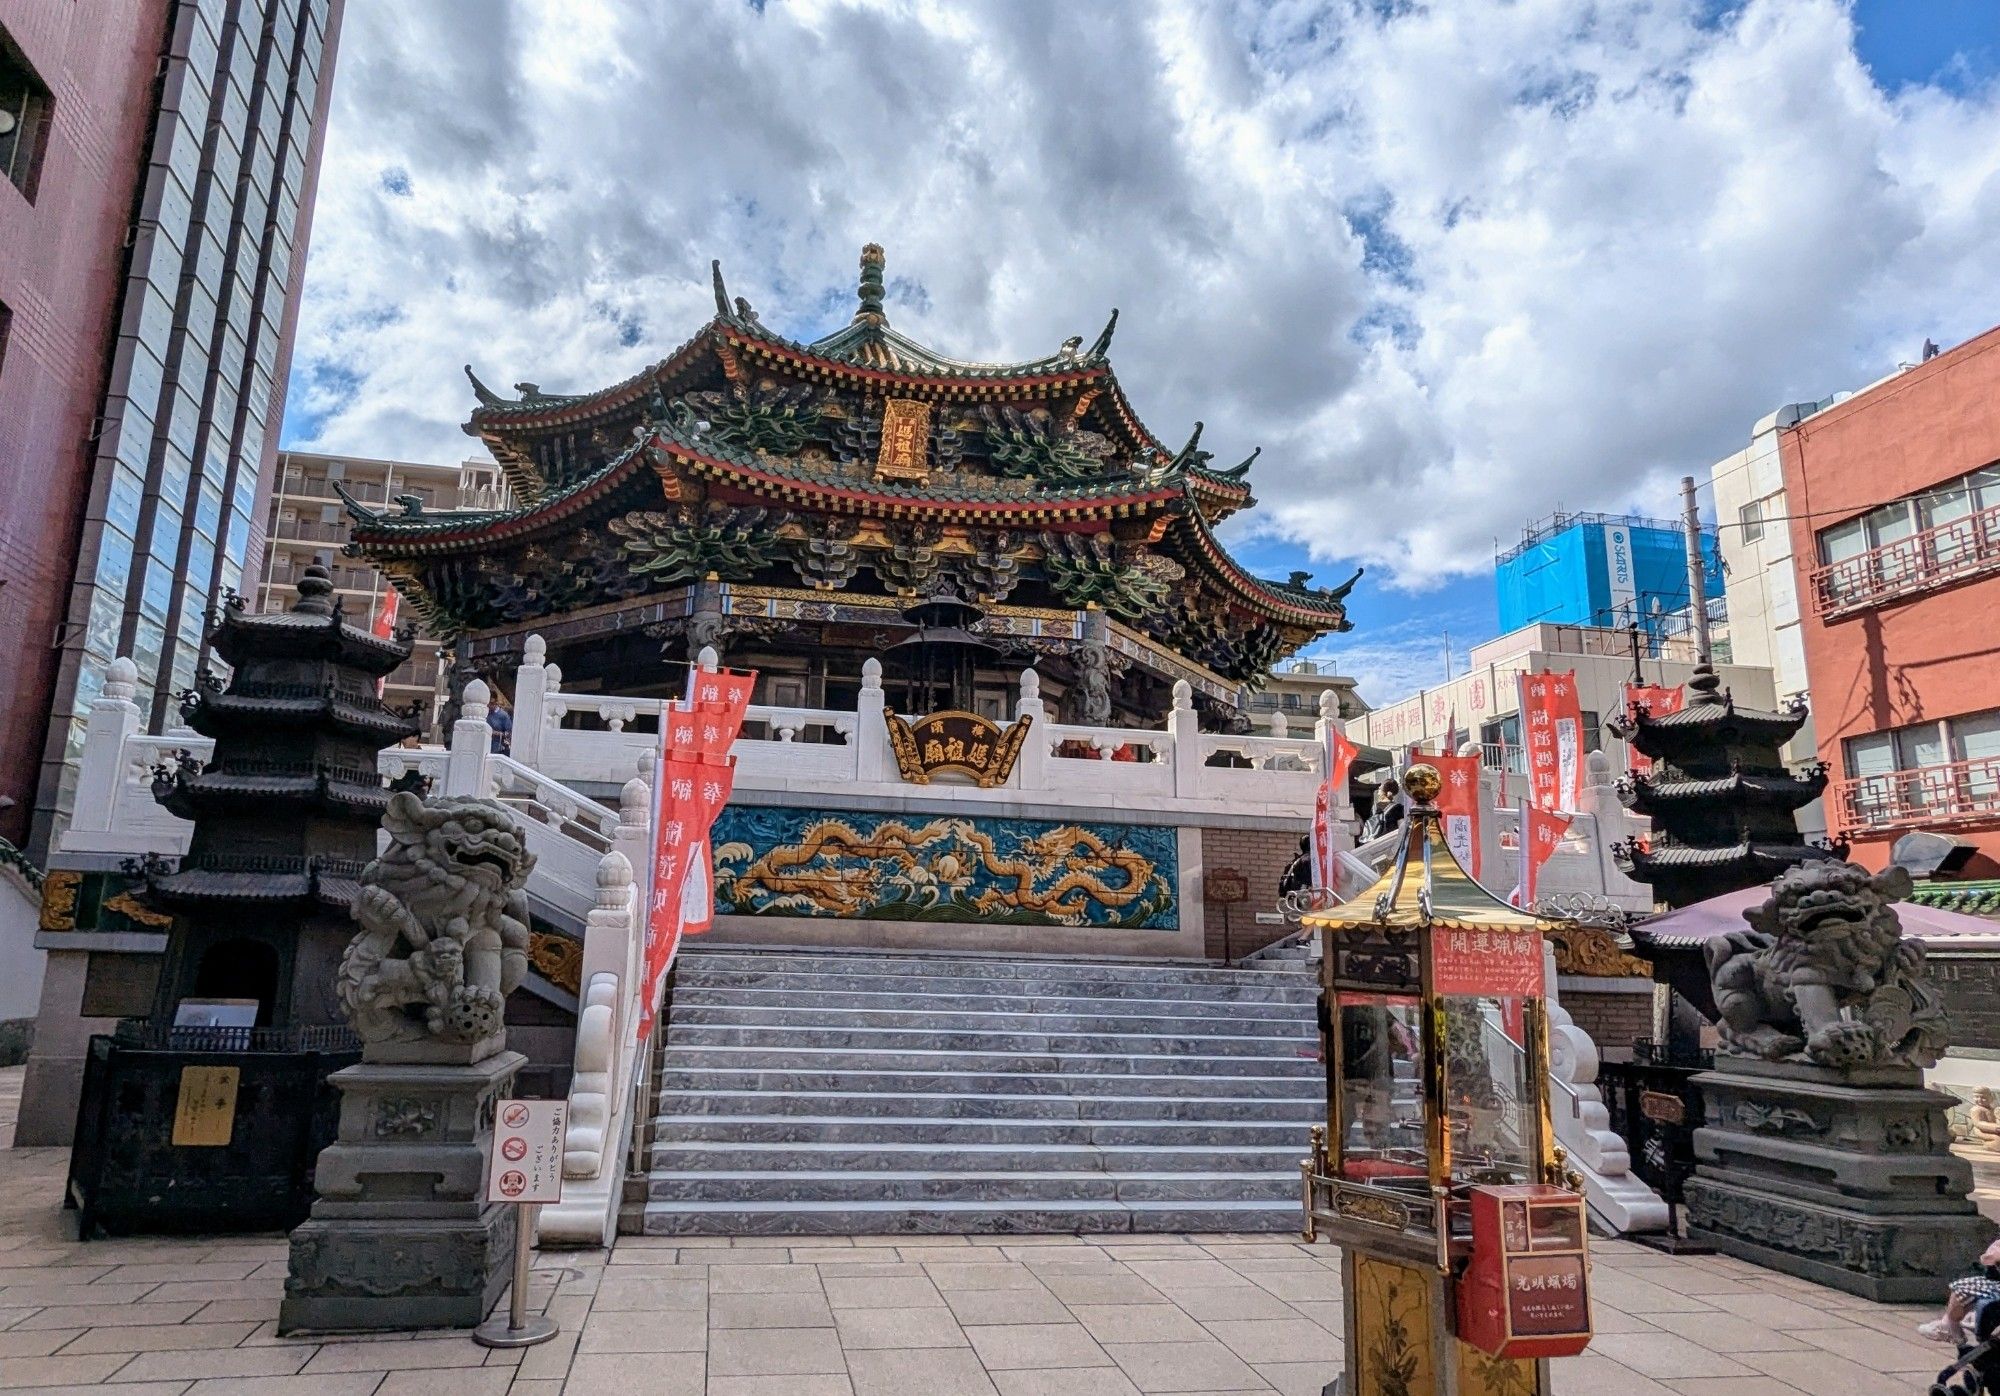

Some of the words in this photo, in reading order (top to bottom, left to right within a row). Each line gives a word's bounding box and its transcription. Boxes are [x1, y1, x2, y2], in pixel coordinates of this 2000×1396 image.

[532, 1144, 544, 1192] ございます
[549, 1107, 562, 1182] ご協力ありがとう
